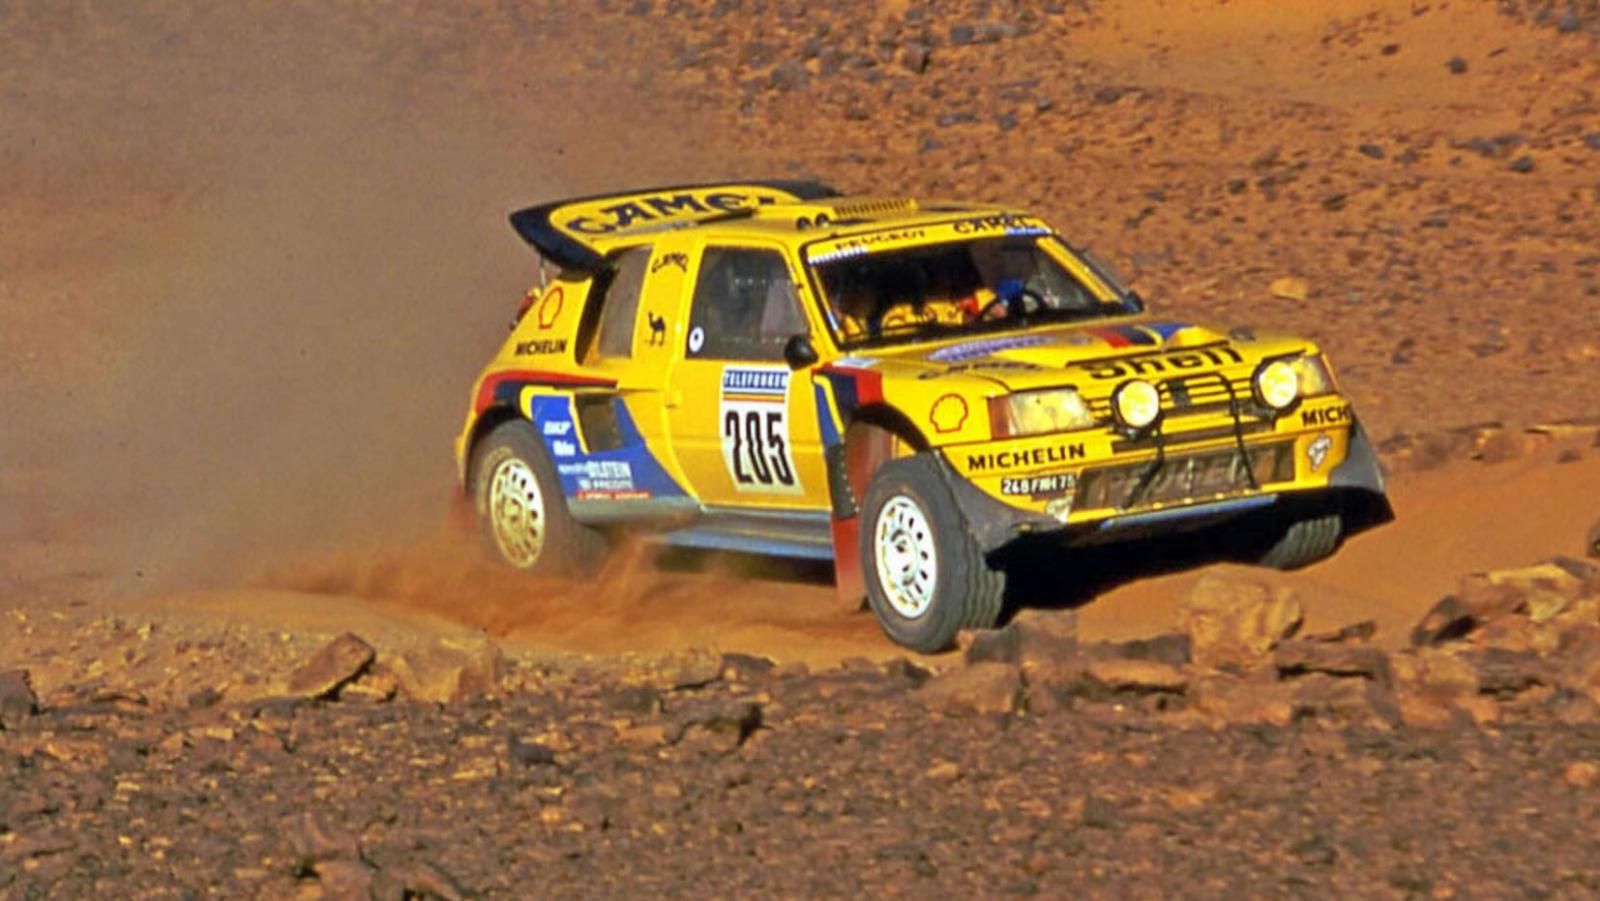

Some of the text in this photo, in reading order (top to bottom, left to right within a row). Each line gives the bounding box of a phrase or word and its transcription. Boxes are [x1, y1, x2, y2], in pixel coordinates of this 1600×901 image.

[514, 339, 568, 356] MICHELIN
[1080, 347, 1244, 380] Shell
[725, 410, 795, 487] 205
[967, 443, 1085, 471] MICHELIN
